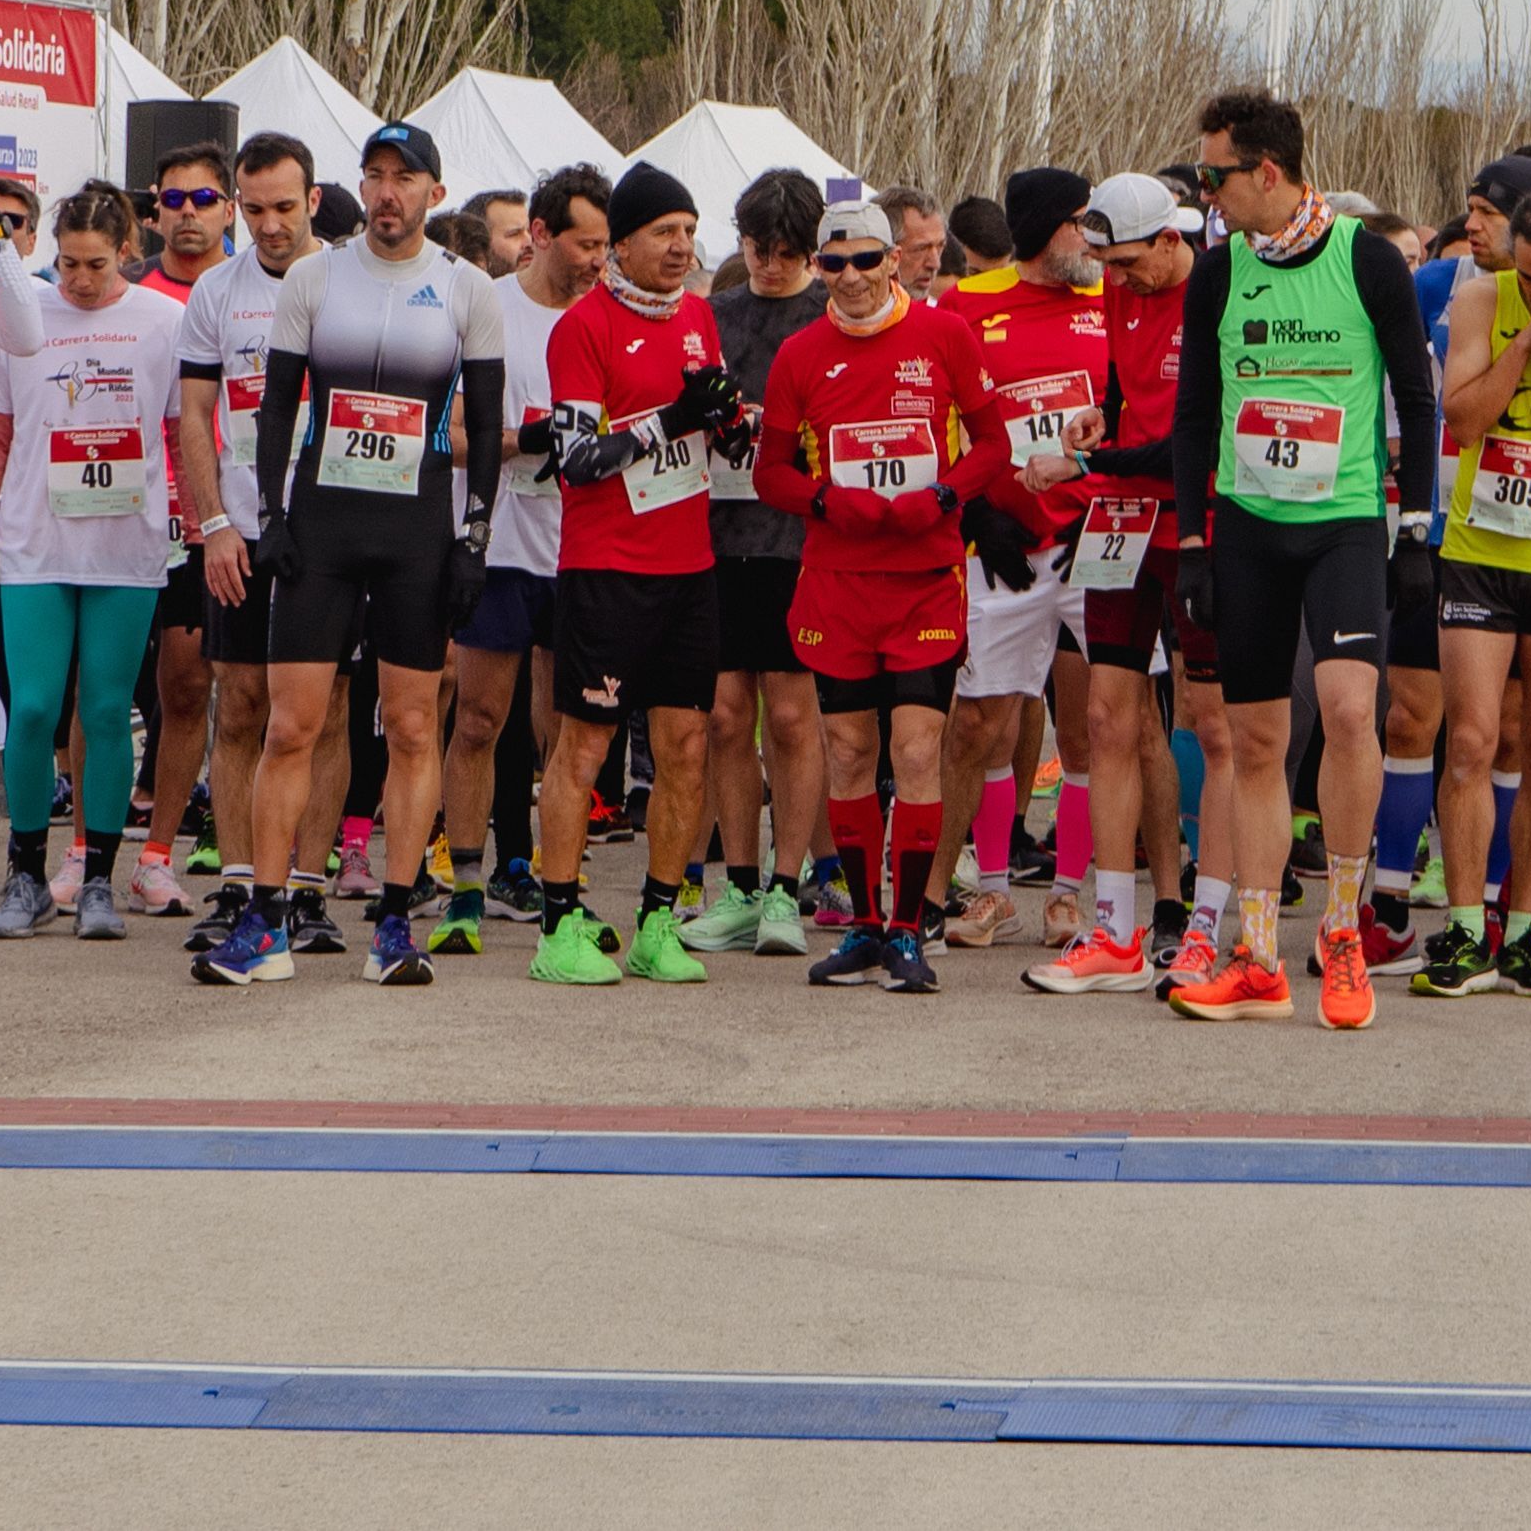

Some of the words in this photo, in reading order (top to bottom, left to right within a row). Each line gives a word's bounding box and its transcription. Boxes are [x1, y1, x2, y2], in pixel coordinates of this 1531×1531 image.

[19, 93, 40, 111] Renal
[52, 334, 90, 347] Carrera
[92, 332, 138, 343] Solidaria
[1272, 318, 1303, 336] pan
[1274, 329, 1341, 345] moreno
[1024, 412, 1064, 442] 147
[345, 430, 397, 462] 296
[651, 439, 691, 476] 240
[1265, 438, 1300, 469] 43
[81, 461, 113, 489] 40
[863, 459, 907, 488] 170
[1100, 533, 1126, 561] 22
[797, 627, 824, 647] ESP
